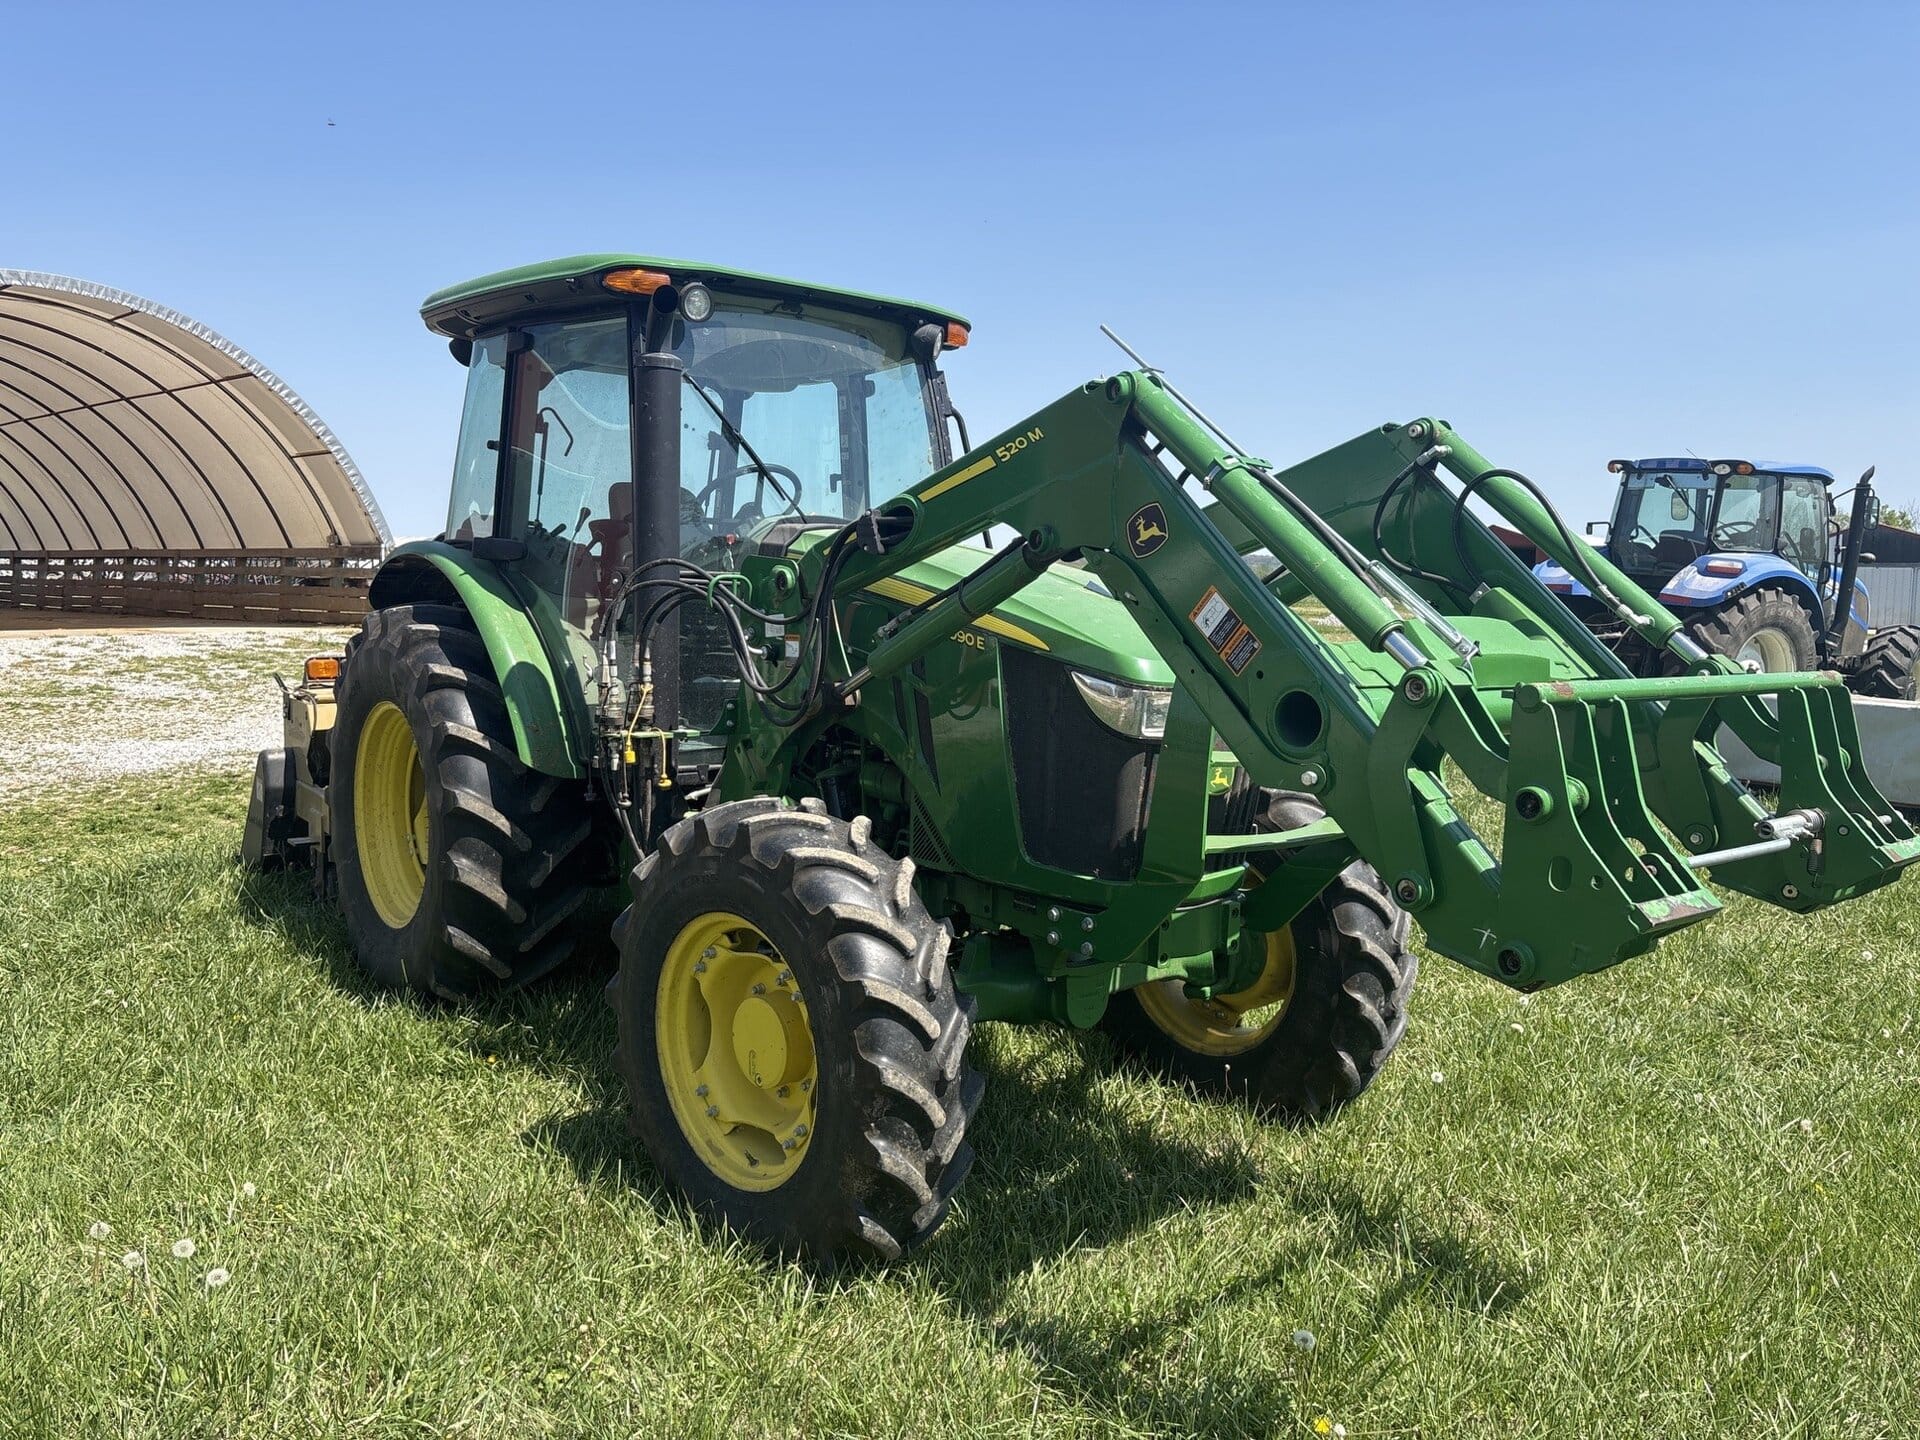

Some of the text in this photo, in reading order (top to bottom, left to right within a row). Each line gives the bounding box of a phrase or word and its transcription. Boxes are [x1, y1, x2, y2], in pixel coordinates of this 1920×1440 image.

[995, 427, 1044, 462] 520 M
[976, 636, 985, 650] E
